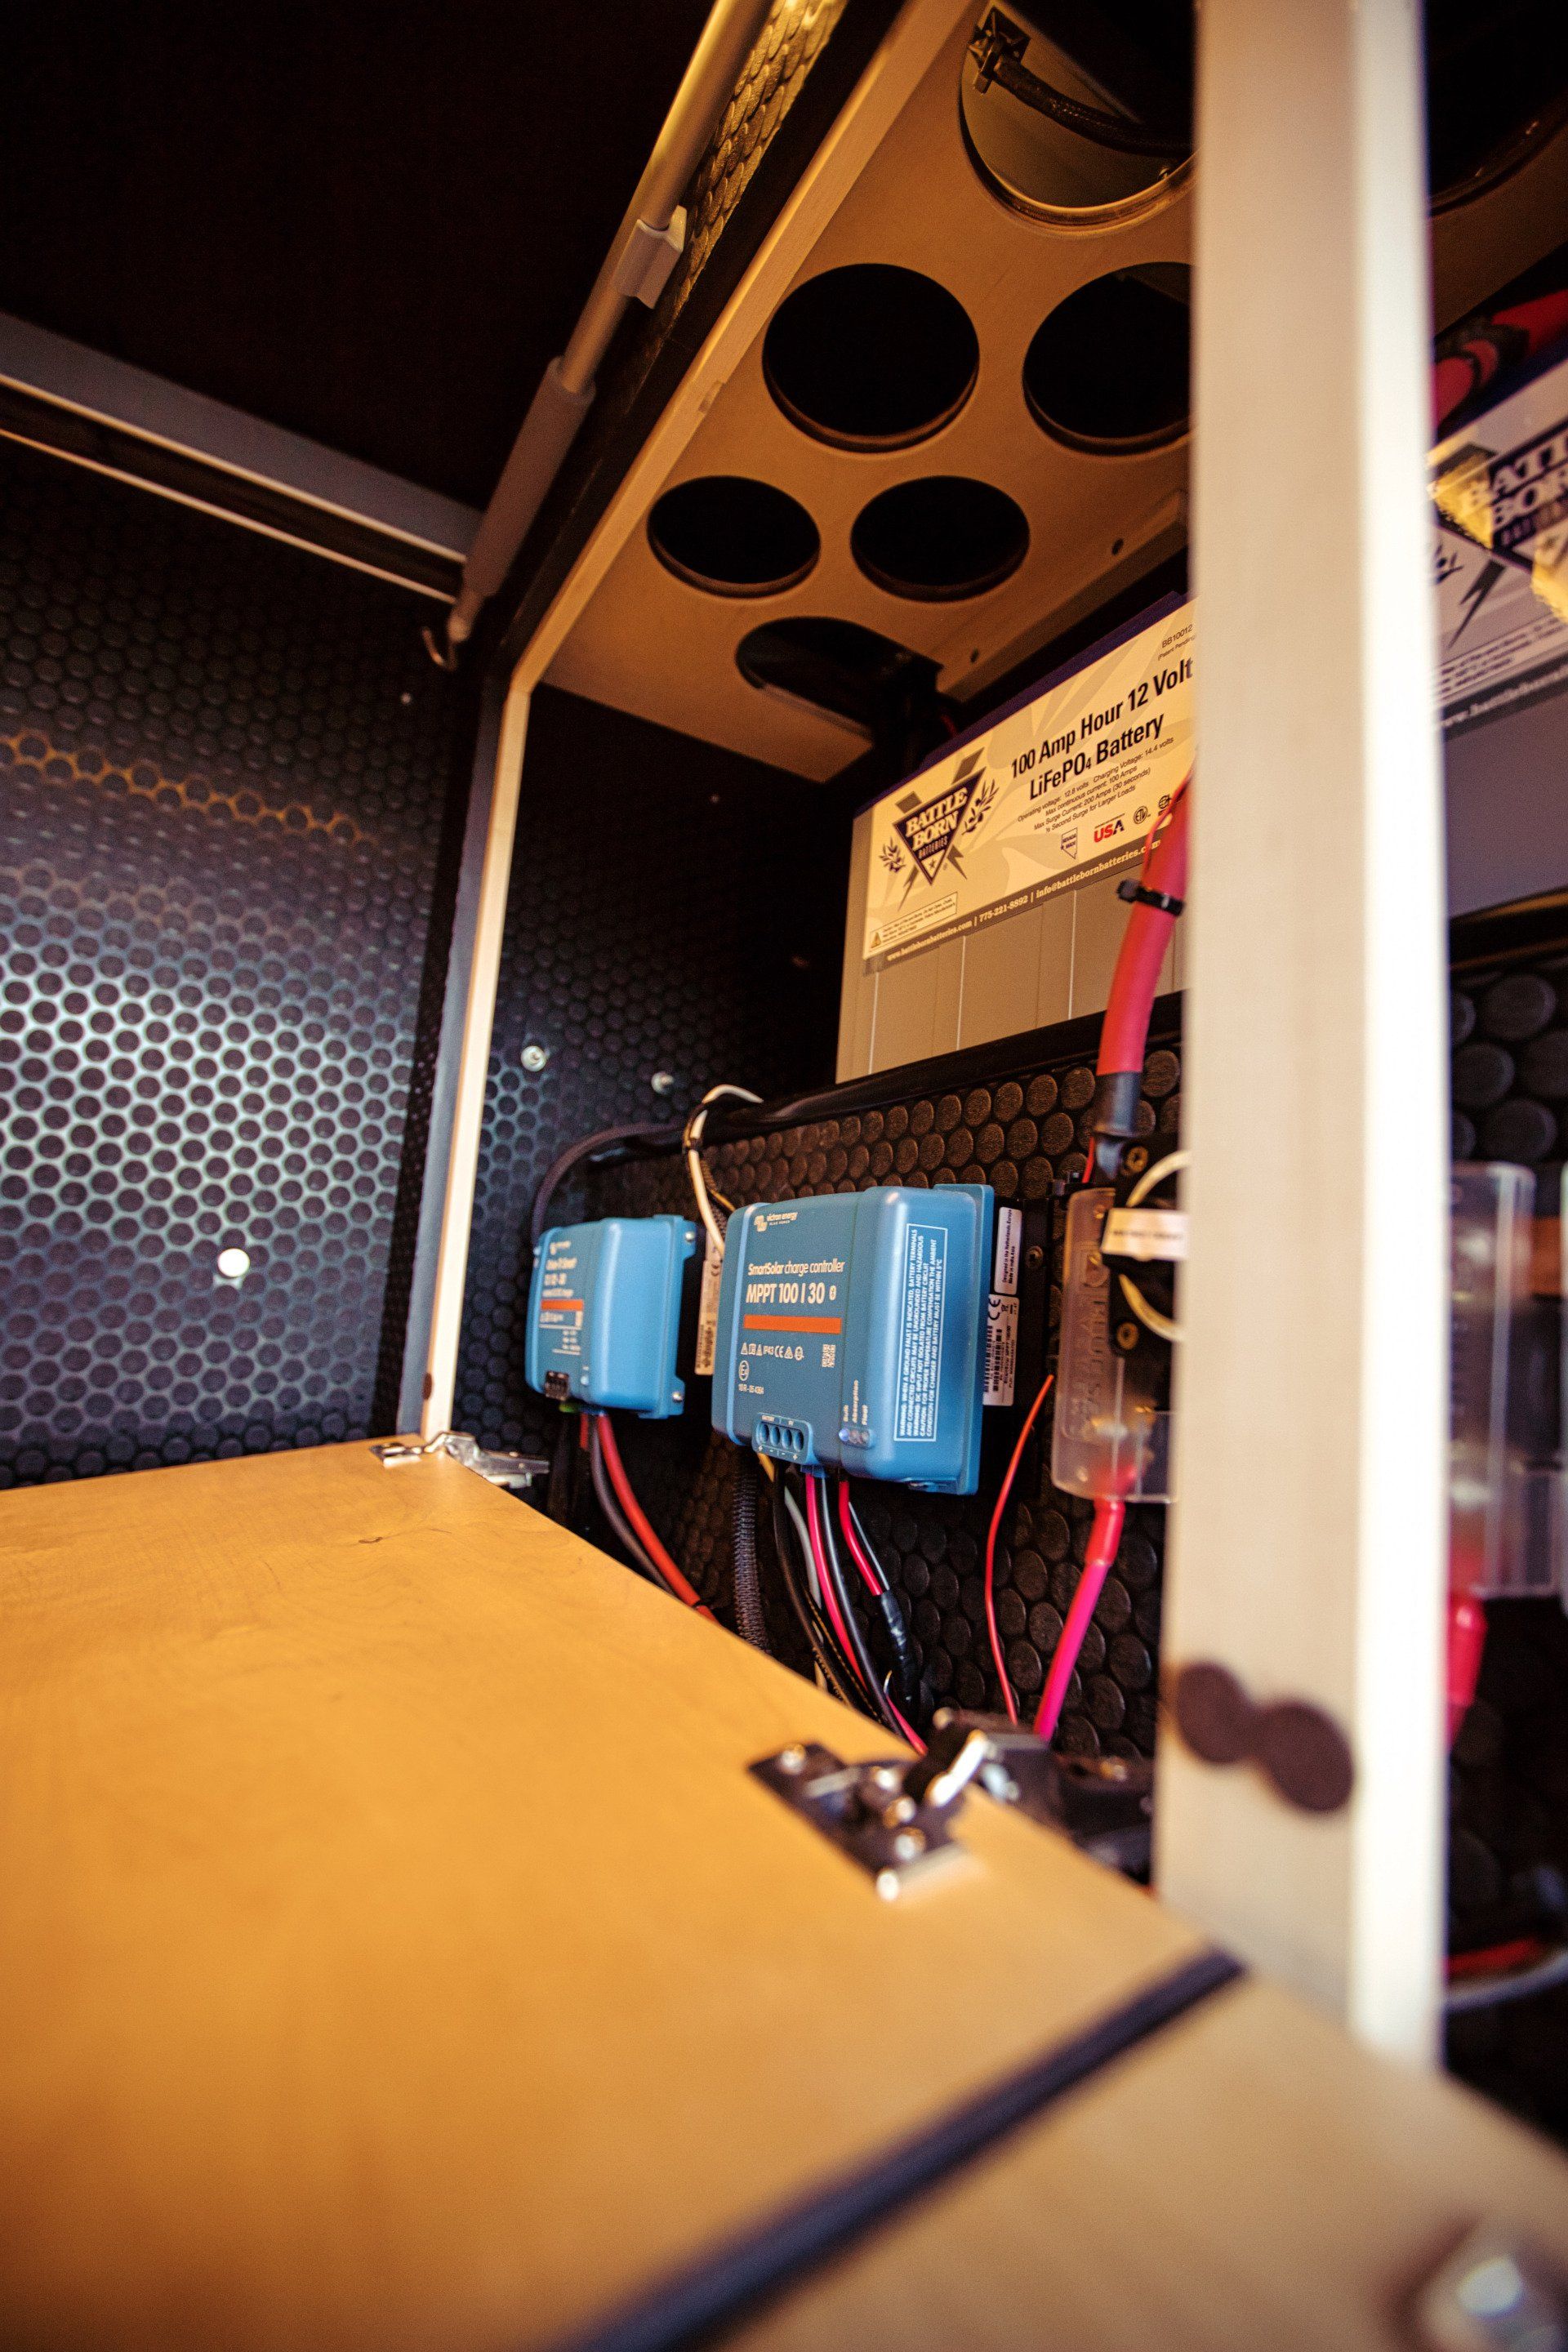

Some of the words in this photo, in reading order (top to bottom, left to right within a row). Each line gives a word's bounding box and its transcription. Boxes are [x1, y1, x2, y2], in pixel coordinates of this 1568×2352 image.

[1162, 624, 1192, 648] BB10012
[1012, 749, 1036, 778] 100
[1040, 730, 1076, 764] Amp
[1081, 702, 1123, 740] Hour
[1129, 683, 1148, 711] 12
[1152, 657, 1193, 697] Volt
[1097, 714, 1164, 764] Battery
[1018, 806, 1041, 822] Operating
[1065, 787, 1076, 797] 12.8
[1076, 782, 1089, 791] volts
[1094, 766, 1119, 783] Charging
[1120, 753, 1143, 768] Voltage:
[1145, 745, 1158, 755] 14.4
[1160, 737, 1174, 748] volts
[1046, 808, 1056, 816] Max
[1058, 792, 1085, 810] continuous
[1110, 774, 1119, 783] 100
[1120, 766, 1137, 778] Amps
[1046, 813, 1061, 825] Surge
[1084, 795, 1094, 805] 200
[1095, 788, 1111, 800] Amps
[1123, 768, 1151, 786] seconds)
[906, 787, 967, 837] BATTLE
[912, 811, 958, 851] BORN
[1052, 816, 1071, 831] Second
[1073, 808, 1089, 820] Surge
[1098, 795, 1116, 808] Larger
[1117, 786, 1135, 798] Loads
[1094, 820, 1125, 843] USA
[1036, 837, 1160, 898] info@battlebornbatteries.cm
[747, 1261, 784, 1276] SmartSolar
[785, 1260, 808, 1277] charge
[809, 1258, 845, 1274] controller
[746, 1283, 777, 1303] MPPT
[778, 1282, 799, 1304] 100
[808, 1282, 826, 1304] 30
[927, 1278, 935, 1325] COMPENSATION
[915, 1393, 921, 1402] DC
